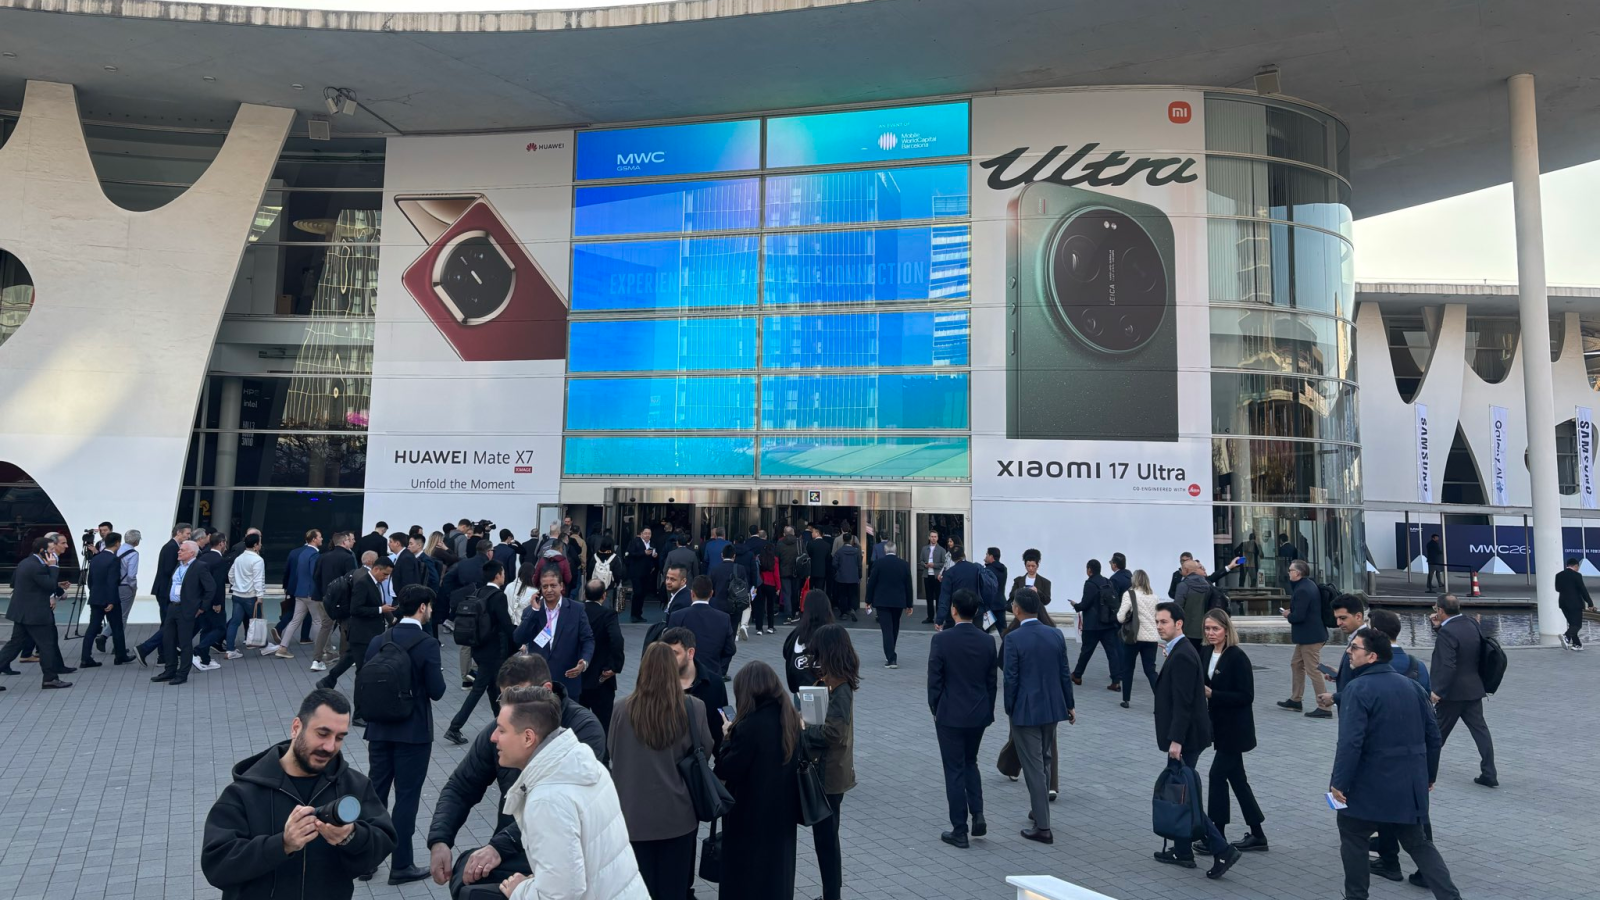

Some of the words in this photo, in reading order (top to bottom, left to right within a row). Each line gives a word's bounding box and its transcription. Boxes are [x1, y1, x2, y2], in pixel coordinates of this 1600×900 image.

[617, 151, 665, 165] MWC
[979, 142, 1198, 190] Ultra
[243, 399, 258, 408] intel
[394, 450, 467, 464] HUAWEI
[473, 451, 510, 464] Mate
[515, 450, 534, 464] X7
[1109, 463, 1129, 479] 17
[1137, 463, 1186, 481] Ultra
[411, 478, 446, 489] Unfold
[450, 479, 467, 489] the
[470, 479, 515, 489] Moment
[1469, 544, 1531, 555] MWC26
